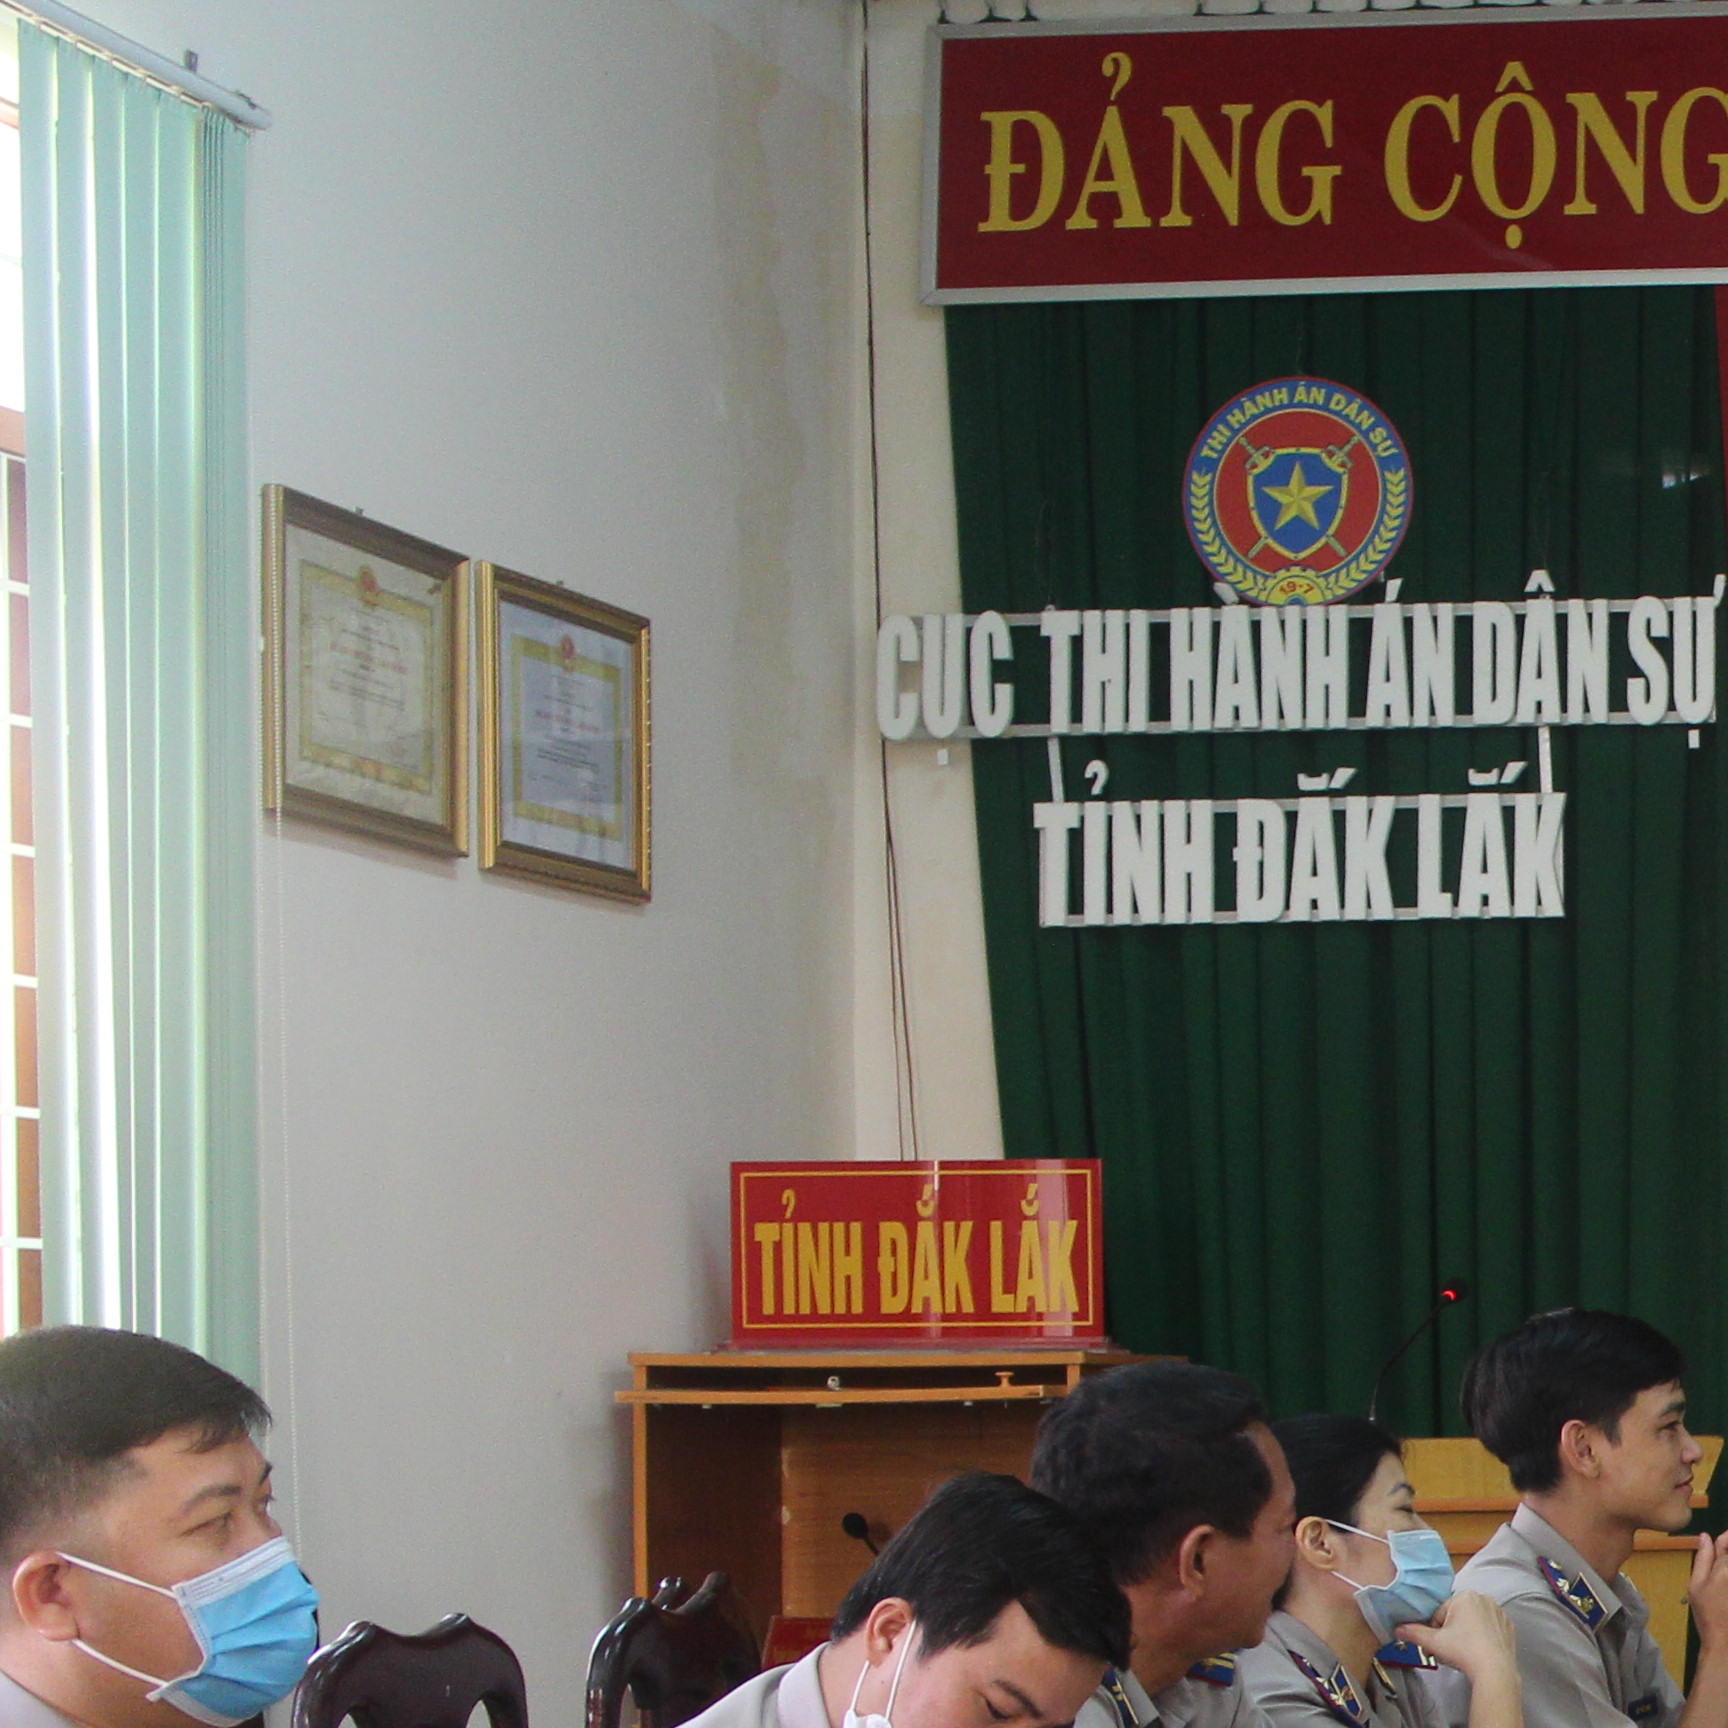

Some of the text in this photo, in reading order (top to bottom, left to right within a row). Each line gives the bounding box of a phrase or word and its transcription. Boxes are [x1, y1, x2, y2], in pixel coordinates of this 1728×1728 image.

[980, 54, 1342, 232] ĐẢNG
[1200, 423, 1231, 459] THI
[1293, 380, 1326, 405] ÁN
[1328, 393, 1378, 431] DÂN
[877, 570, 1728, 766] CỤC THI HÀNH ÁN DÂN SỰ
[1033, 760, 1568, 927] TỈNH ĐẮK LẮK
[754, 1183, 1080, 1316] TỈNH ĐẮK LẮK
